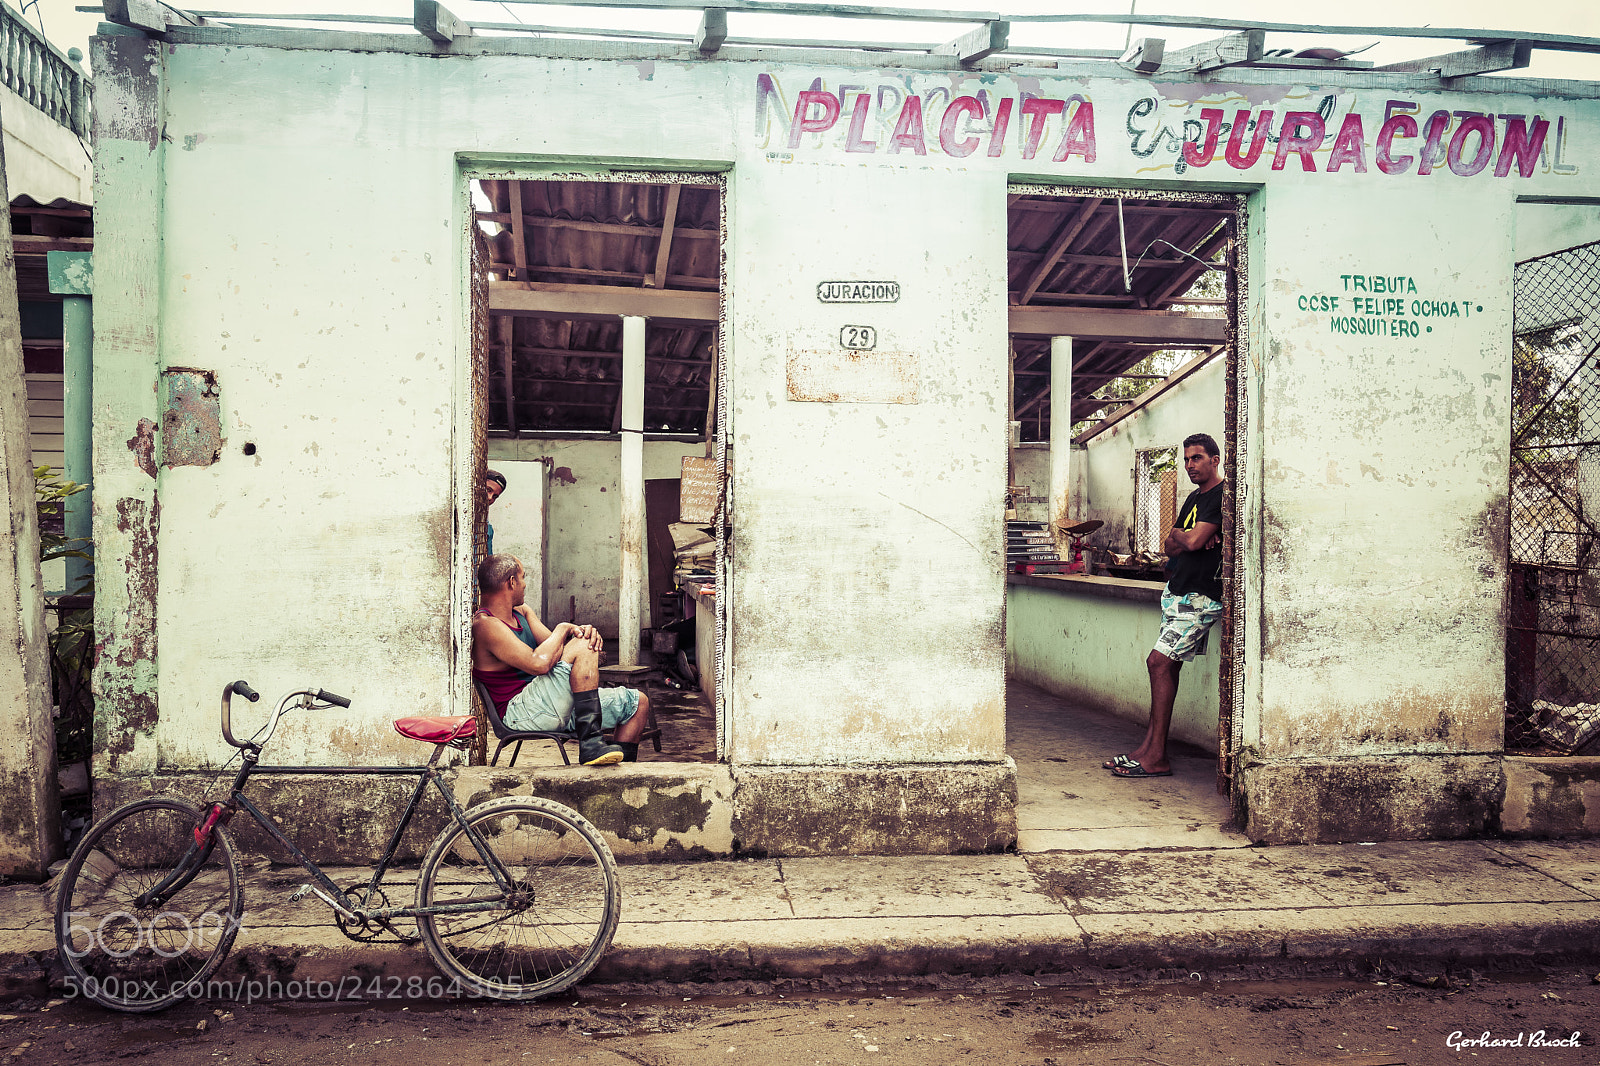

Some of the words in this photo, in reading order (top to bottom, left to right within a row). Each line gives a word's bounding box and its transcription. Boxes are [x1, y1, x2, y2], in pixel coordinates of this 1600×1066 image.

[786, 90, 1097, 164] PLACITA
[1182, 107, 1551, 179] JURACION
[822, 284, 895, 300] JURACION
[1340, 274, 1418, 295] TRIBUTA
[1352, 297, 1405, 317] FELIPE
[848, 328, 870, 347] 29
